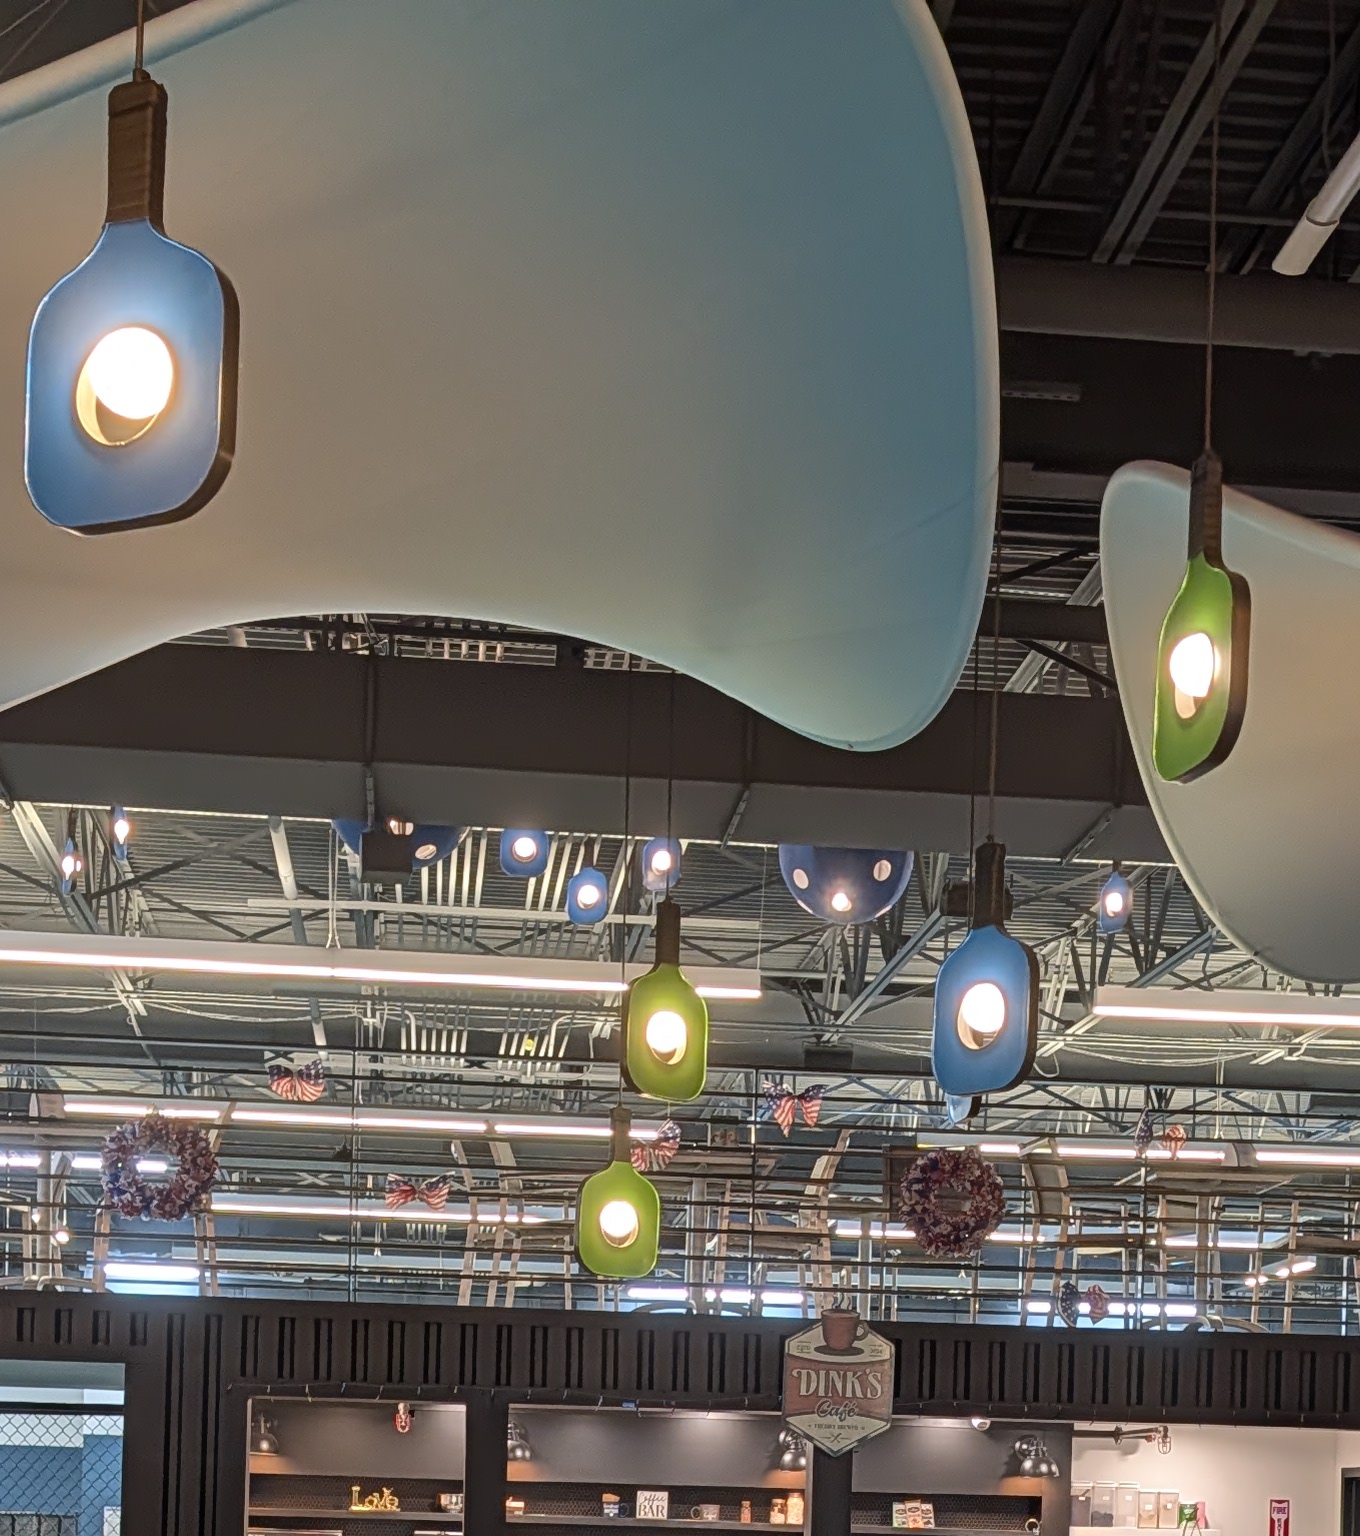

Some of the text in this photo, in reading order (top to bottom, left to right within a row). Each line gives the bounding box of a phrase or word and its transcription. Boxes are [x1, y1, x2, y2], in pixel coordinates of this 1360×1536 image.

[791, 1368, 882, 1399] DINK'S
[815, 1400, 858, 1422] Café
[638, 1504, 665, 1518] BAR
[1272, 1506, 1288, 1515] FIRE
